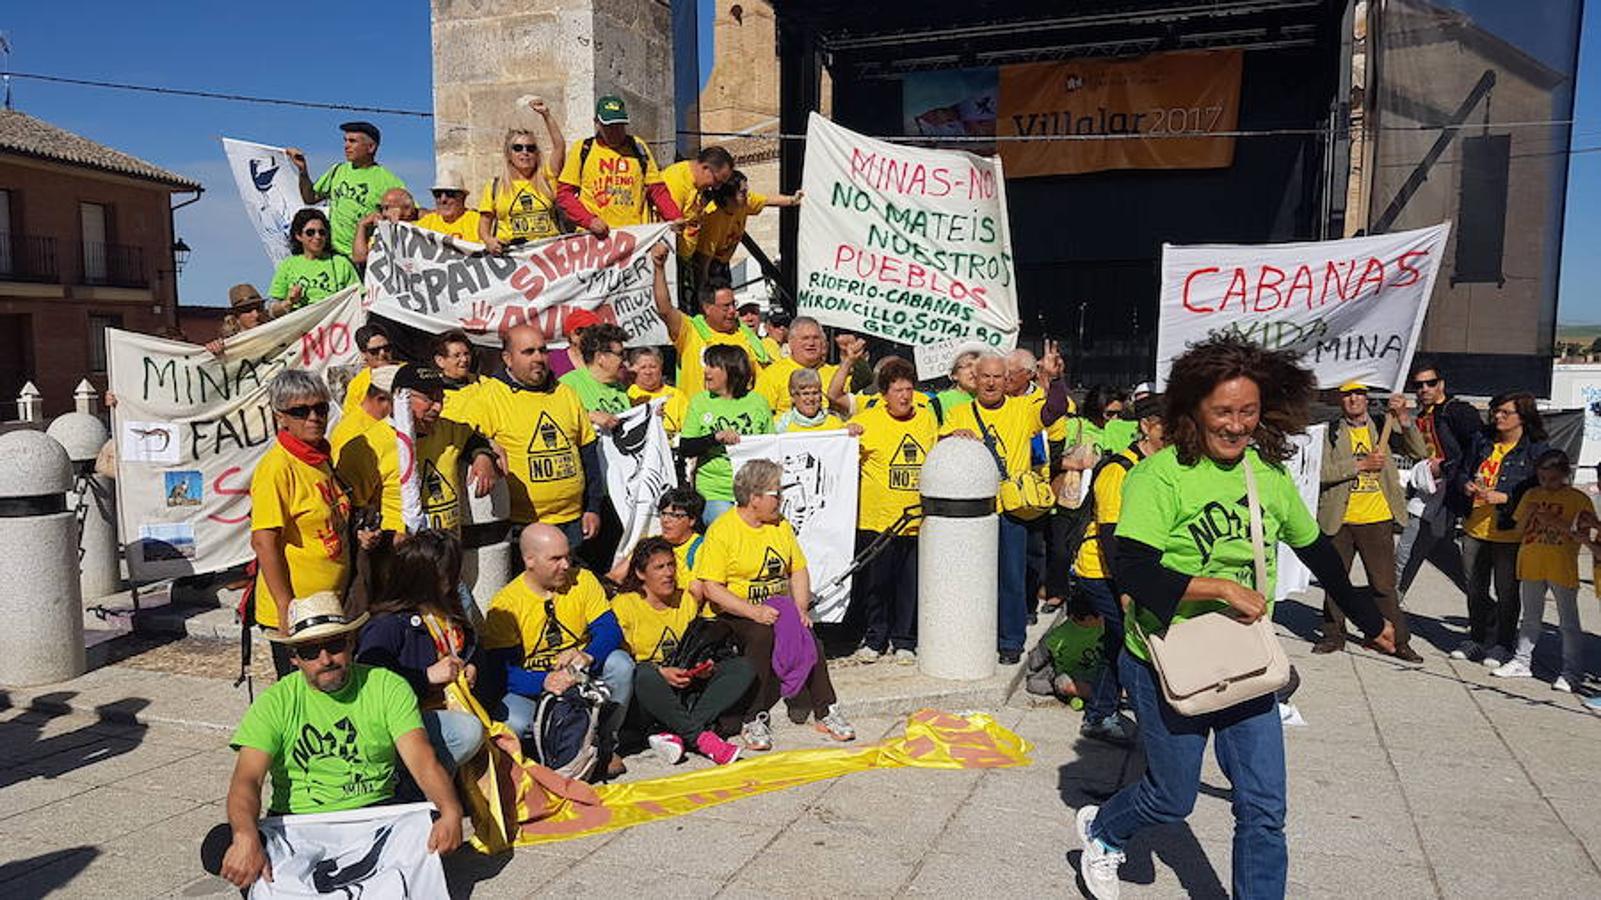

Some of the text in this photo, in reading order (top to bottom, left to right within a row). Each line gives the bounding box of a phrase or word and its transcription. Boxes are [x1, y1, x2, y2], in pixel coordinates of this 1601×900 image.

[598, 157, 629, 173] NO
[831, 181, 873, 212] NO
[510, 230, 637, 301] SIERRA
[835, 244, 987, 310] PUEBLOS
[301, 322, 352, 367] NO
[1315, 333, 1403, 364] MINA
[532, 458, 554, 479] NO
[892, 470, 910, 487] NO
[1187, 500, 1231, 567] NO
[292, 722, 324, 774] NO
